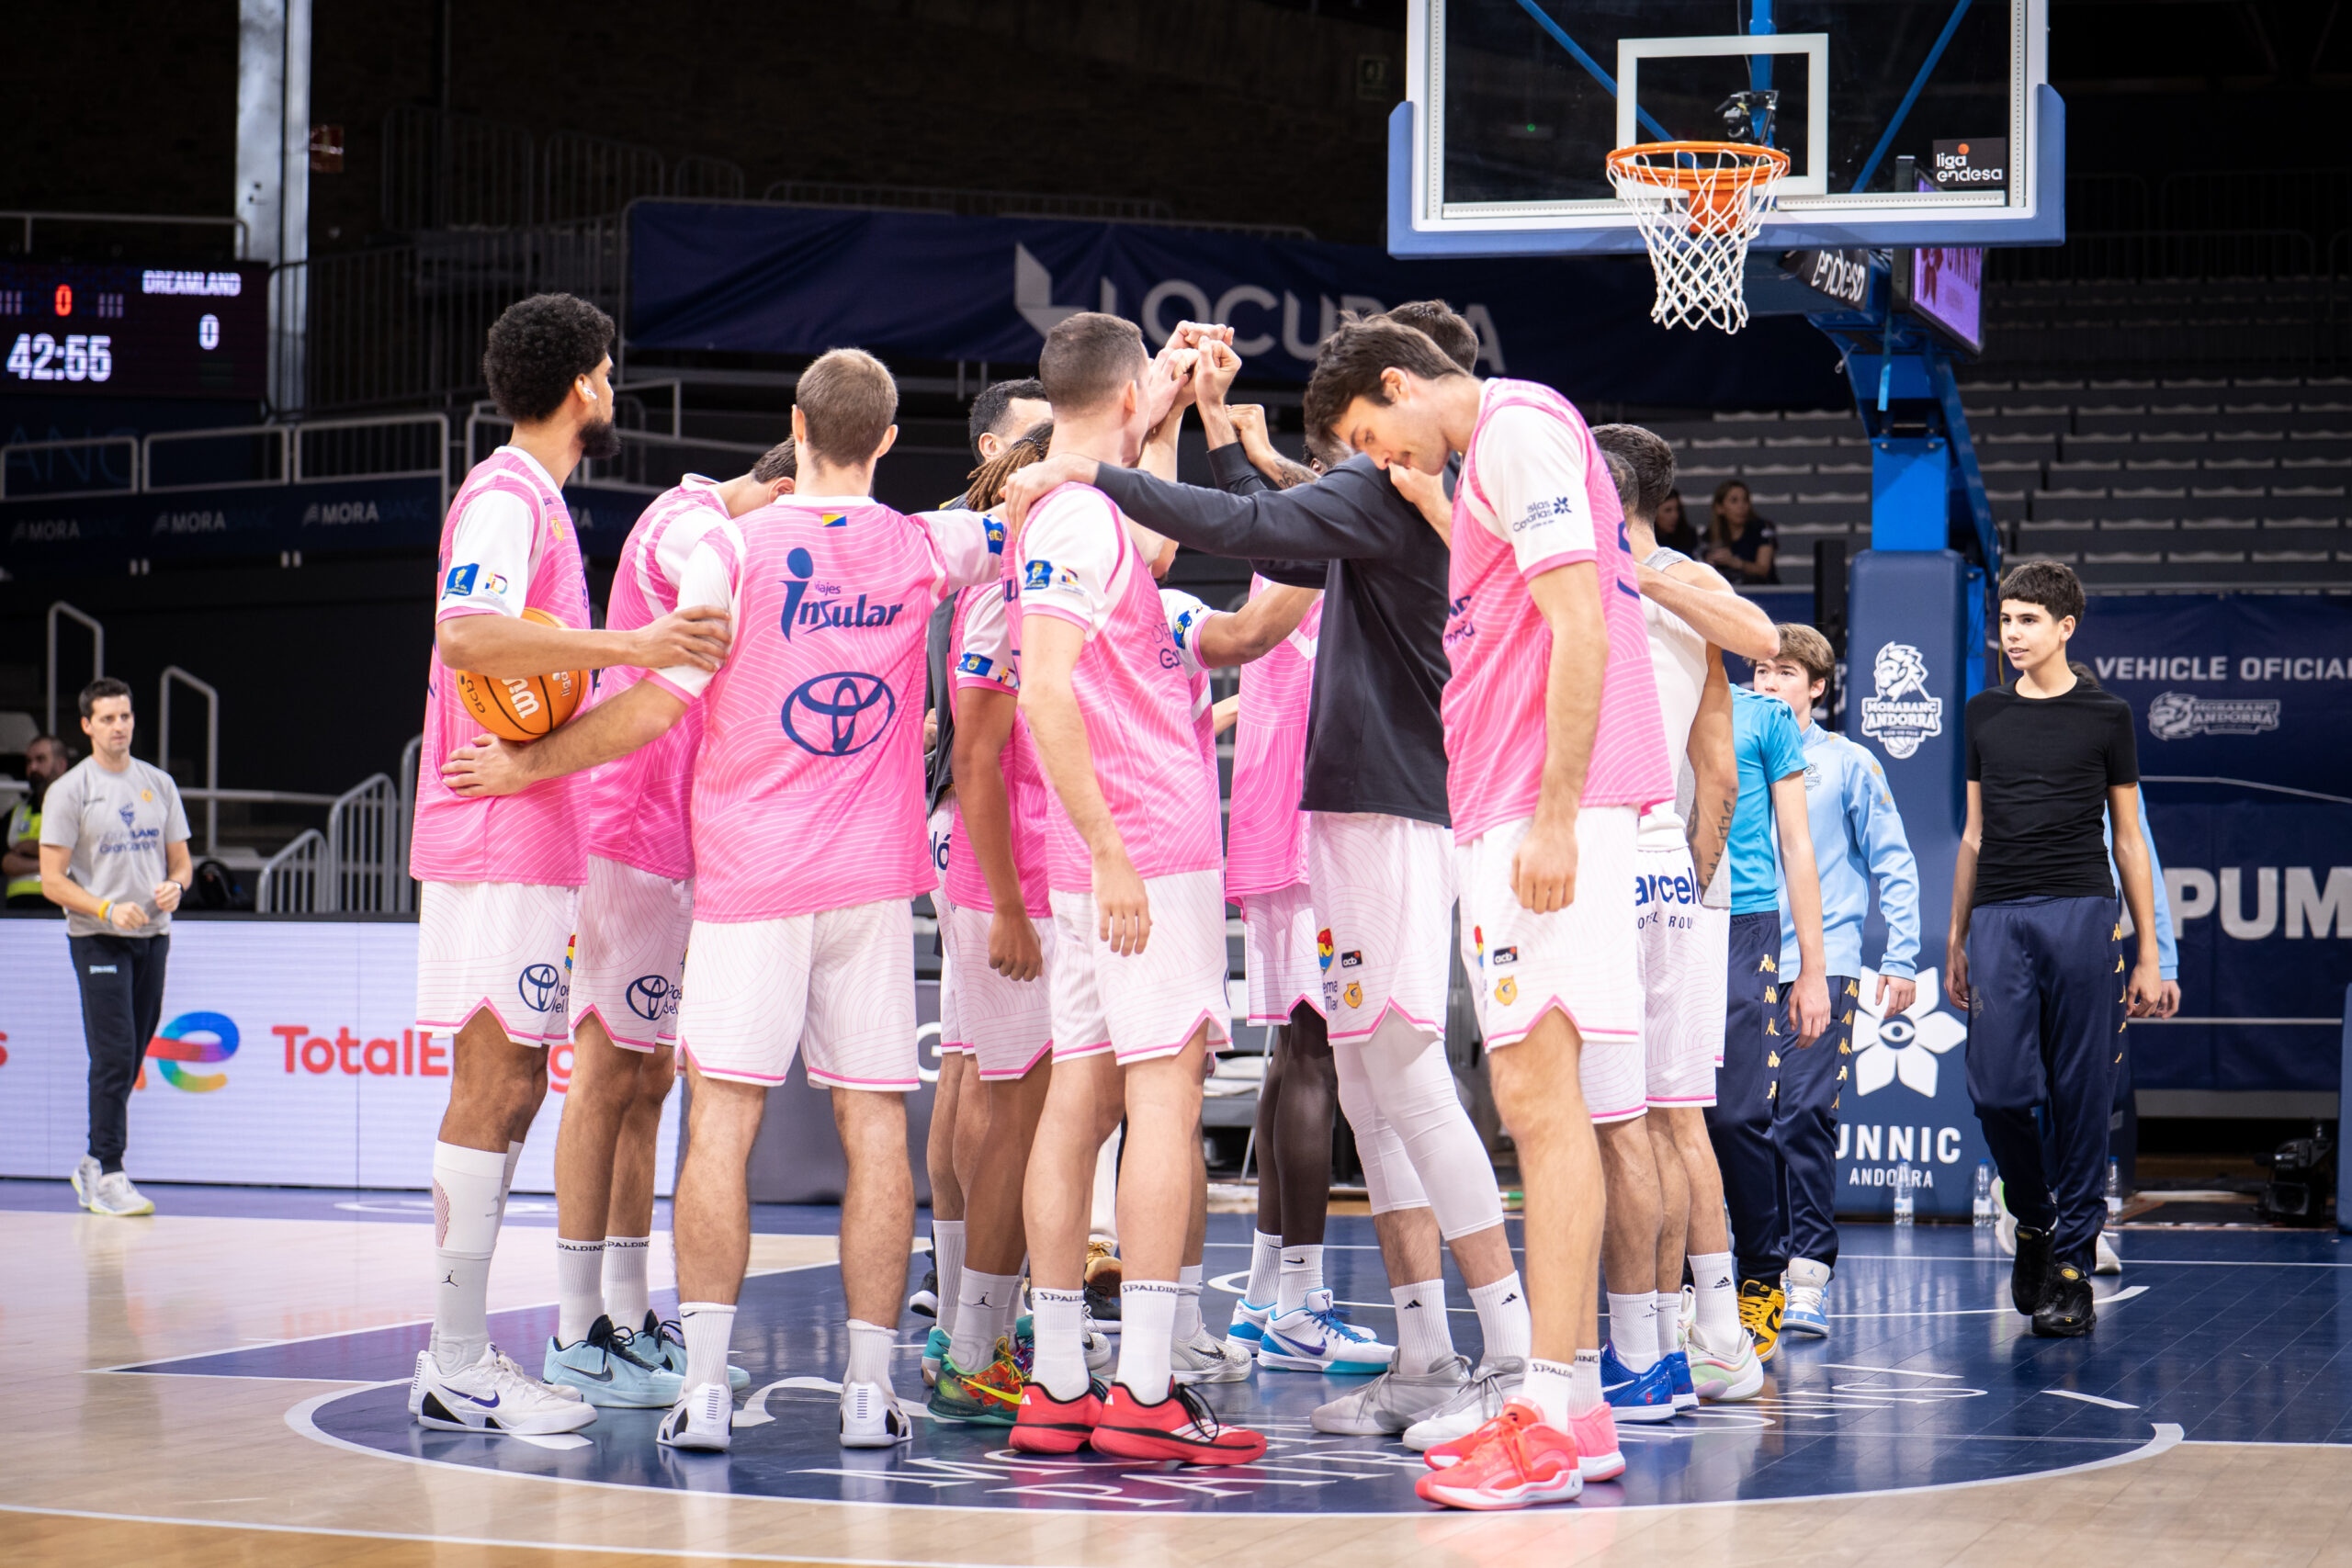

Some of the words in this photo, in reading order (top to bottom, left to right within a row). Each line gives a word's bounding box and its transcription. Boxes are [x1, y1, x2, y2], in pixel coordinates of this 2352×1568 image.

[1936, 153, 1967, 169] liga
[1936, 167, 2003, 183] endesa
[141, 270, 242, 296] DREAMLAND
[1810, 249, 1866, 303] endesa
[54, 284, 73, 316] 0
[198, 313, 220, 351] 0
[6, 333, 112, 382] 42:55
[814, 581, 842, 596] viajes
[2095, 655, 2228, 682] VEHICLE
[465, 679, 487, 714] acb
[1866, 701, 1938, 714] MORABANC
[1865, 712, 1939, 731] ANDORRA
[2192, 710, 2274, 726] ANDORRA
[1342, 956, 1358, 966] acb
[1495, 953, 1514, 964] acb
